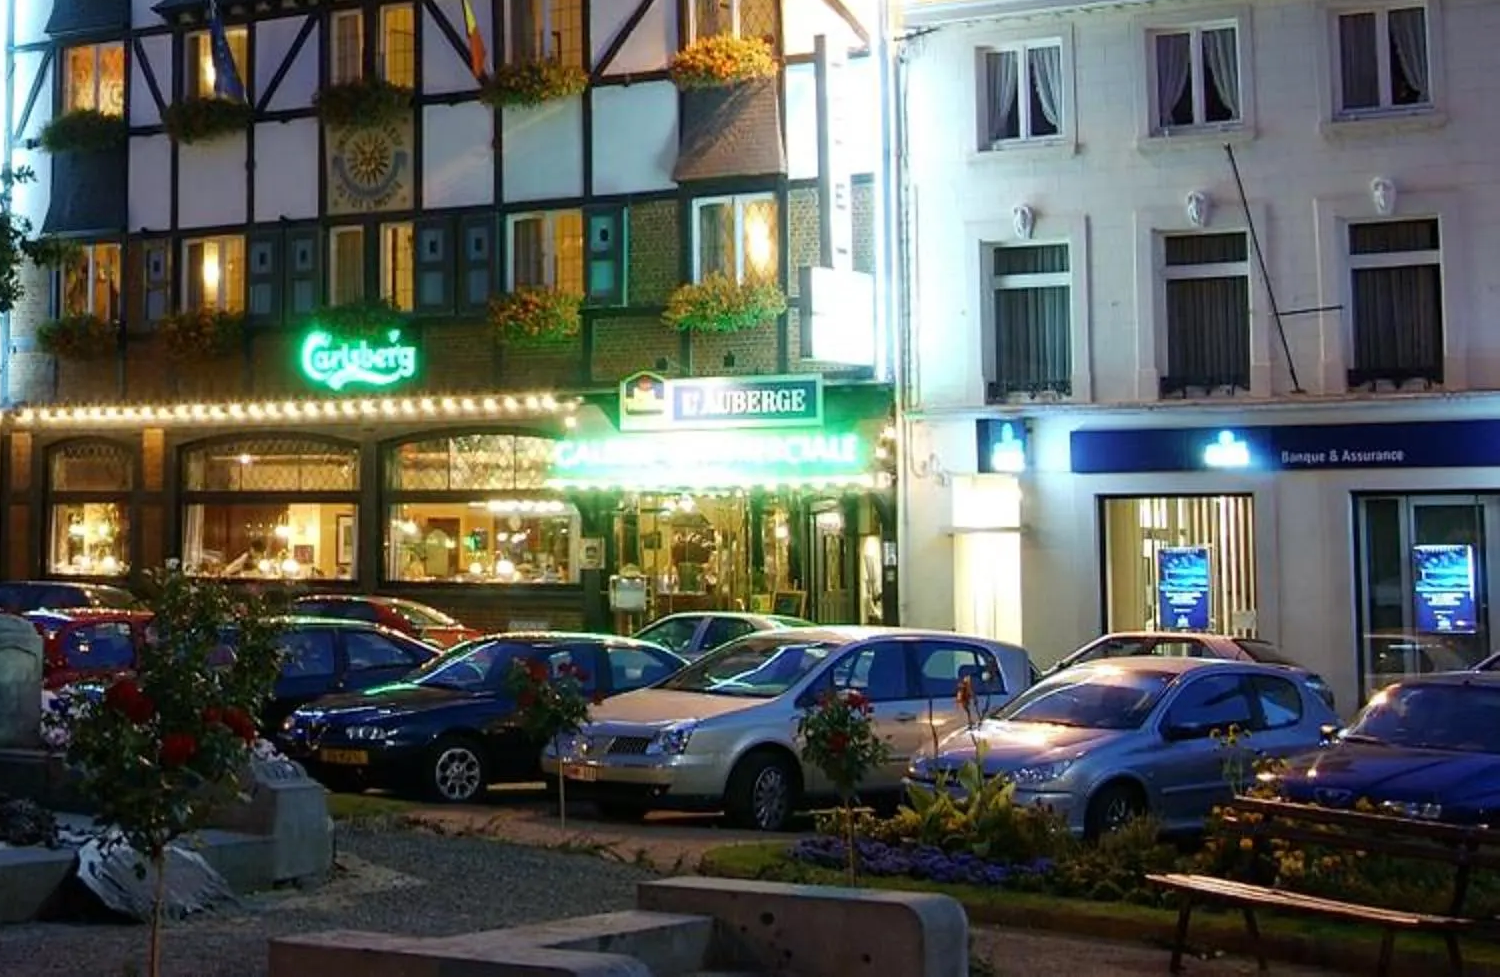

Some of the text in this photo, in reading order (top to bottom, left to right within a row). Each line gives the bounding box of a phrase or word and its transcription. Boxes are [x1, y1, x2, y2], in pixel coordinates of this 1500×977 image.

[302, 329, 416, 390] Carlsberg
[1281, 447, 1404, 464] Banque & Assurance
